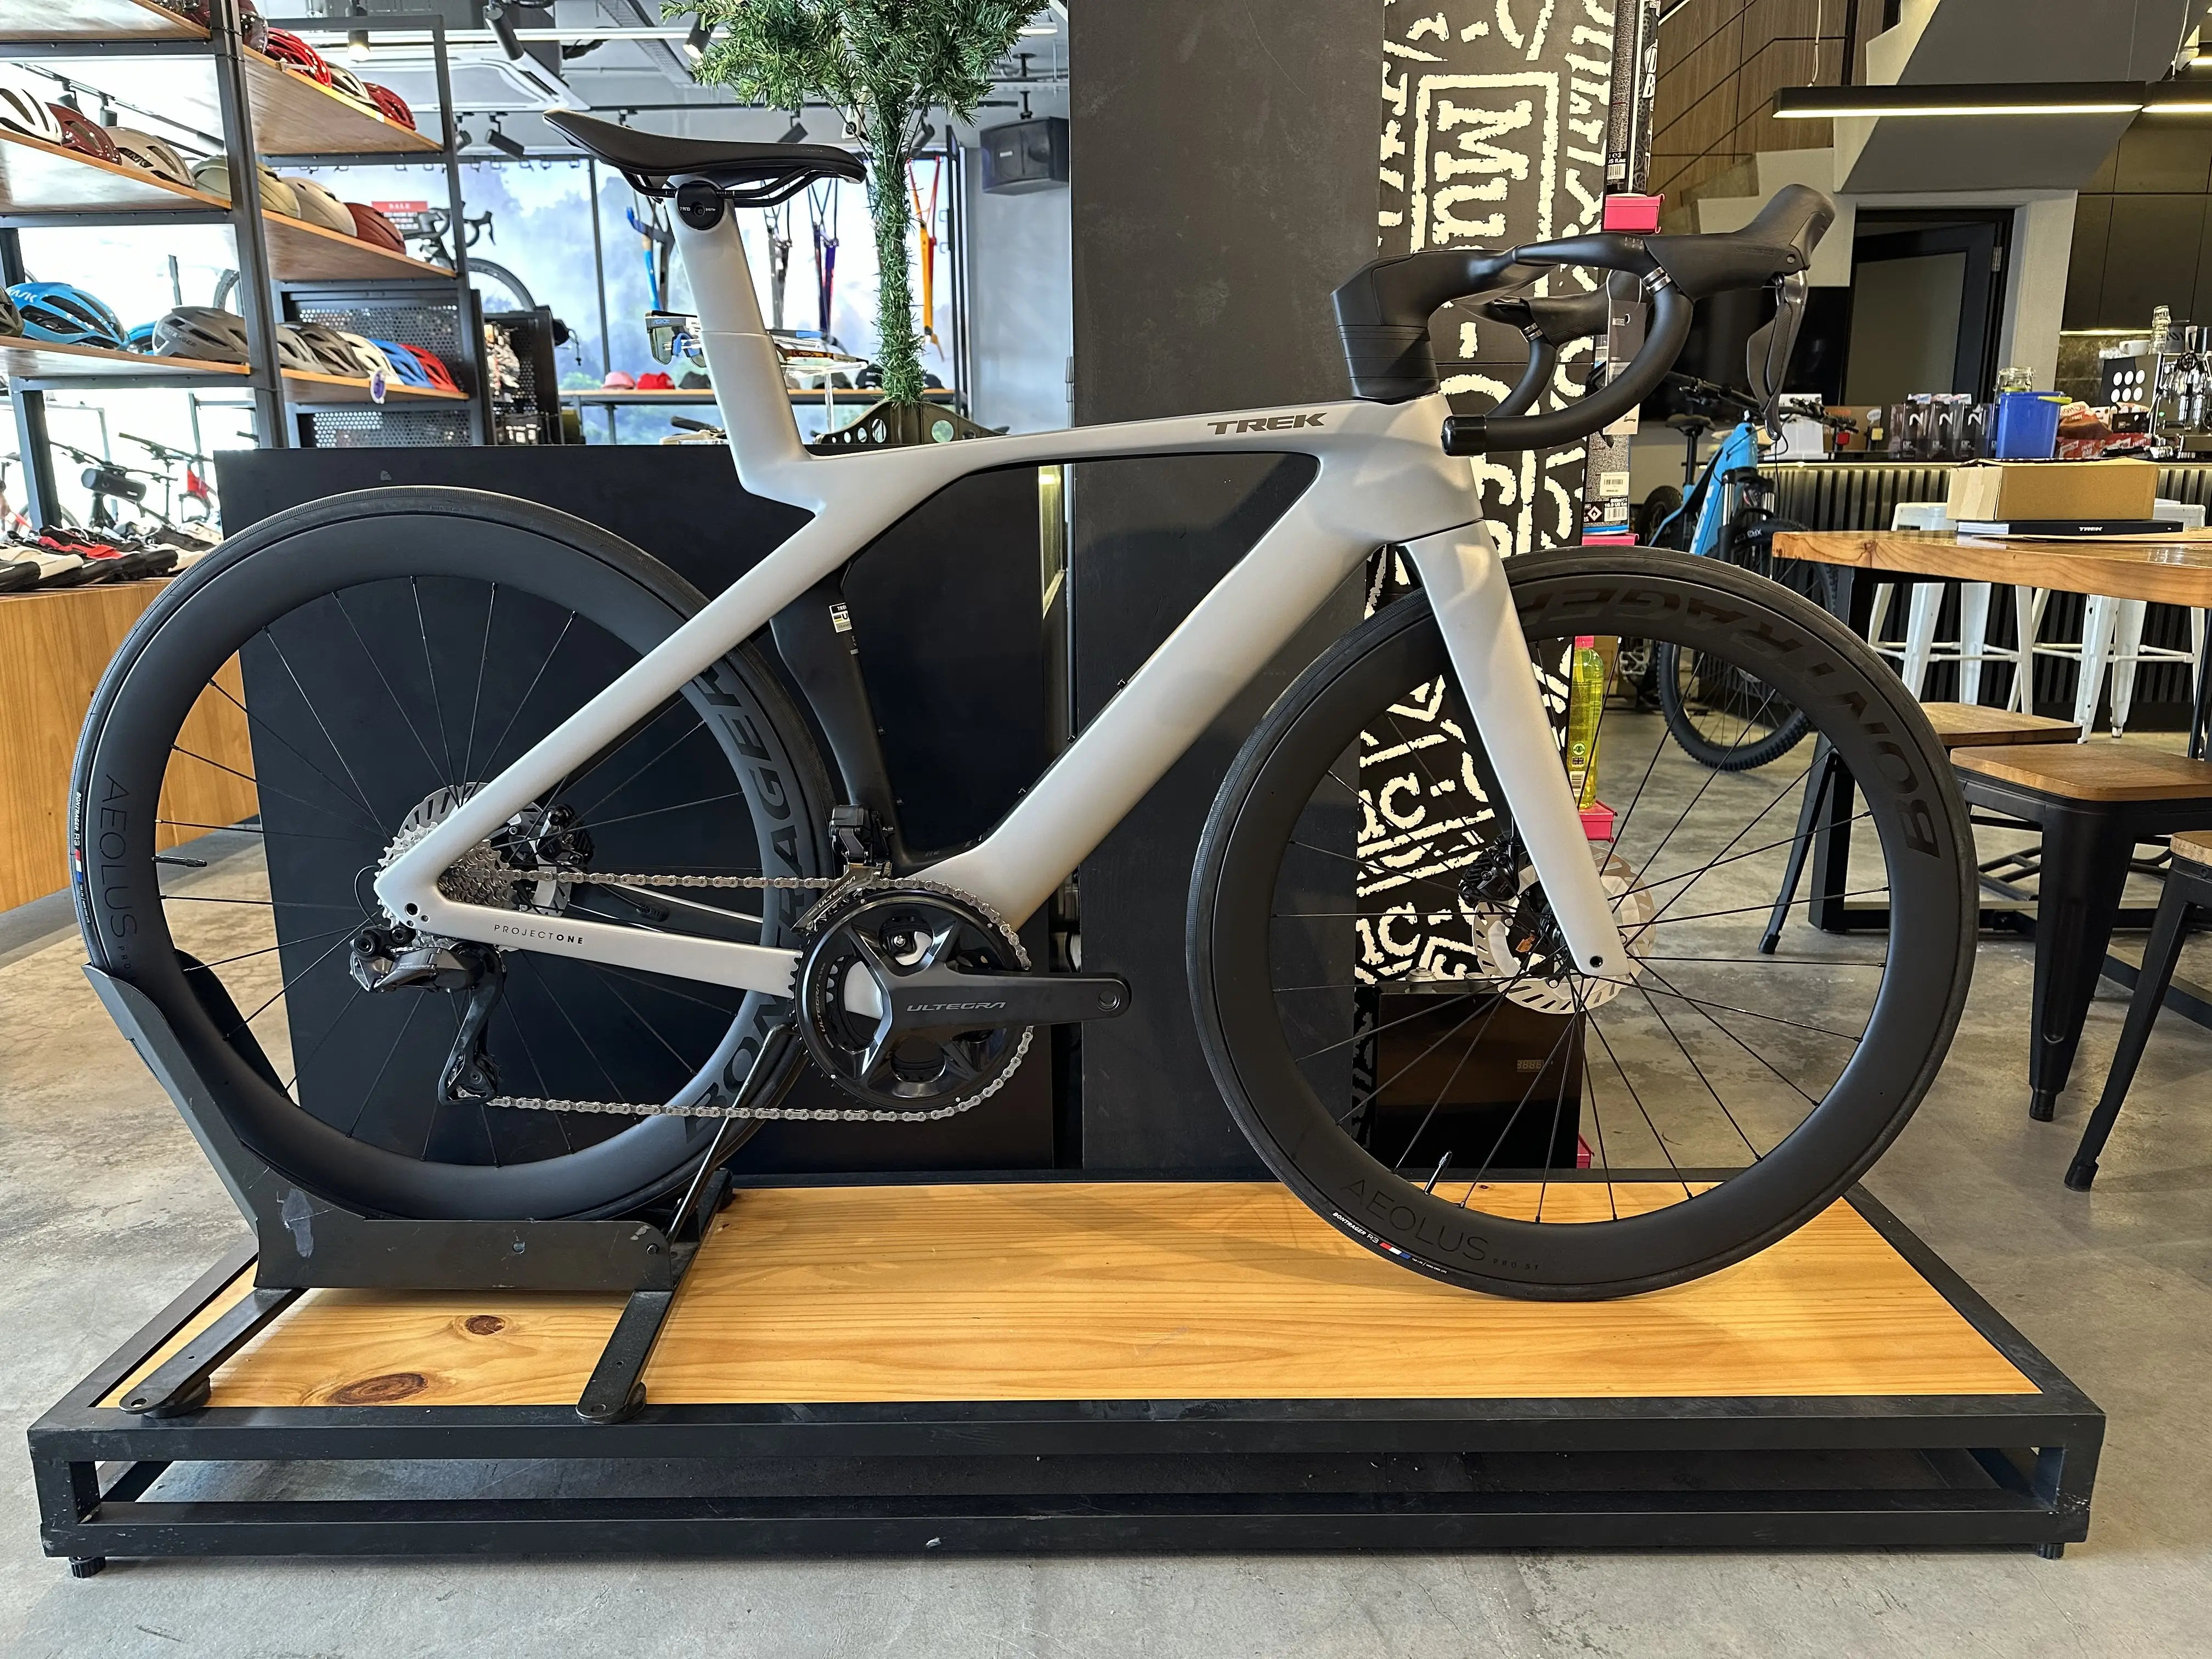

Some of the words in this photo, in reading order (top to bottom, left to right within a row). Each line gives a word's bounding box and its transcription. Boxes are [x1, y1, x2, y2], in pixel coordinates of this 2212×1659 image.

[1207, 413, 1328, 435] TREK
[73, 792, 82, 831] BONTRAGER
[73, 833, 81, 847] R3
[100, 774, 137, 938] AEOLUS
[818, 876, 856, 909] ULTEGRA
[815, 983, 826, 1032] ULTEGRA
[906, 1002, 1006, 1012] ULTEGRA
[1331, 1211, 1367, 1236] BONTRAGER
[1366, 1233, 1380, 1244] R3
[1340, 1179, 1488, 1261] AEOLUS
[1493, 1259, 1517, 1269] PRO
